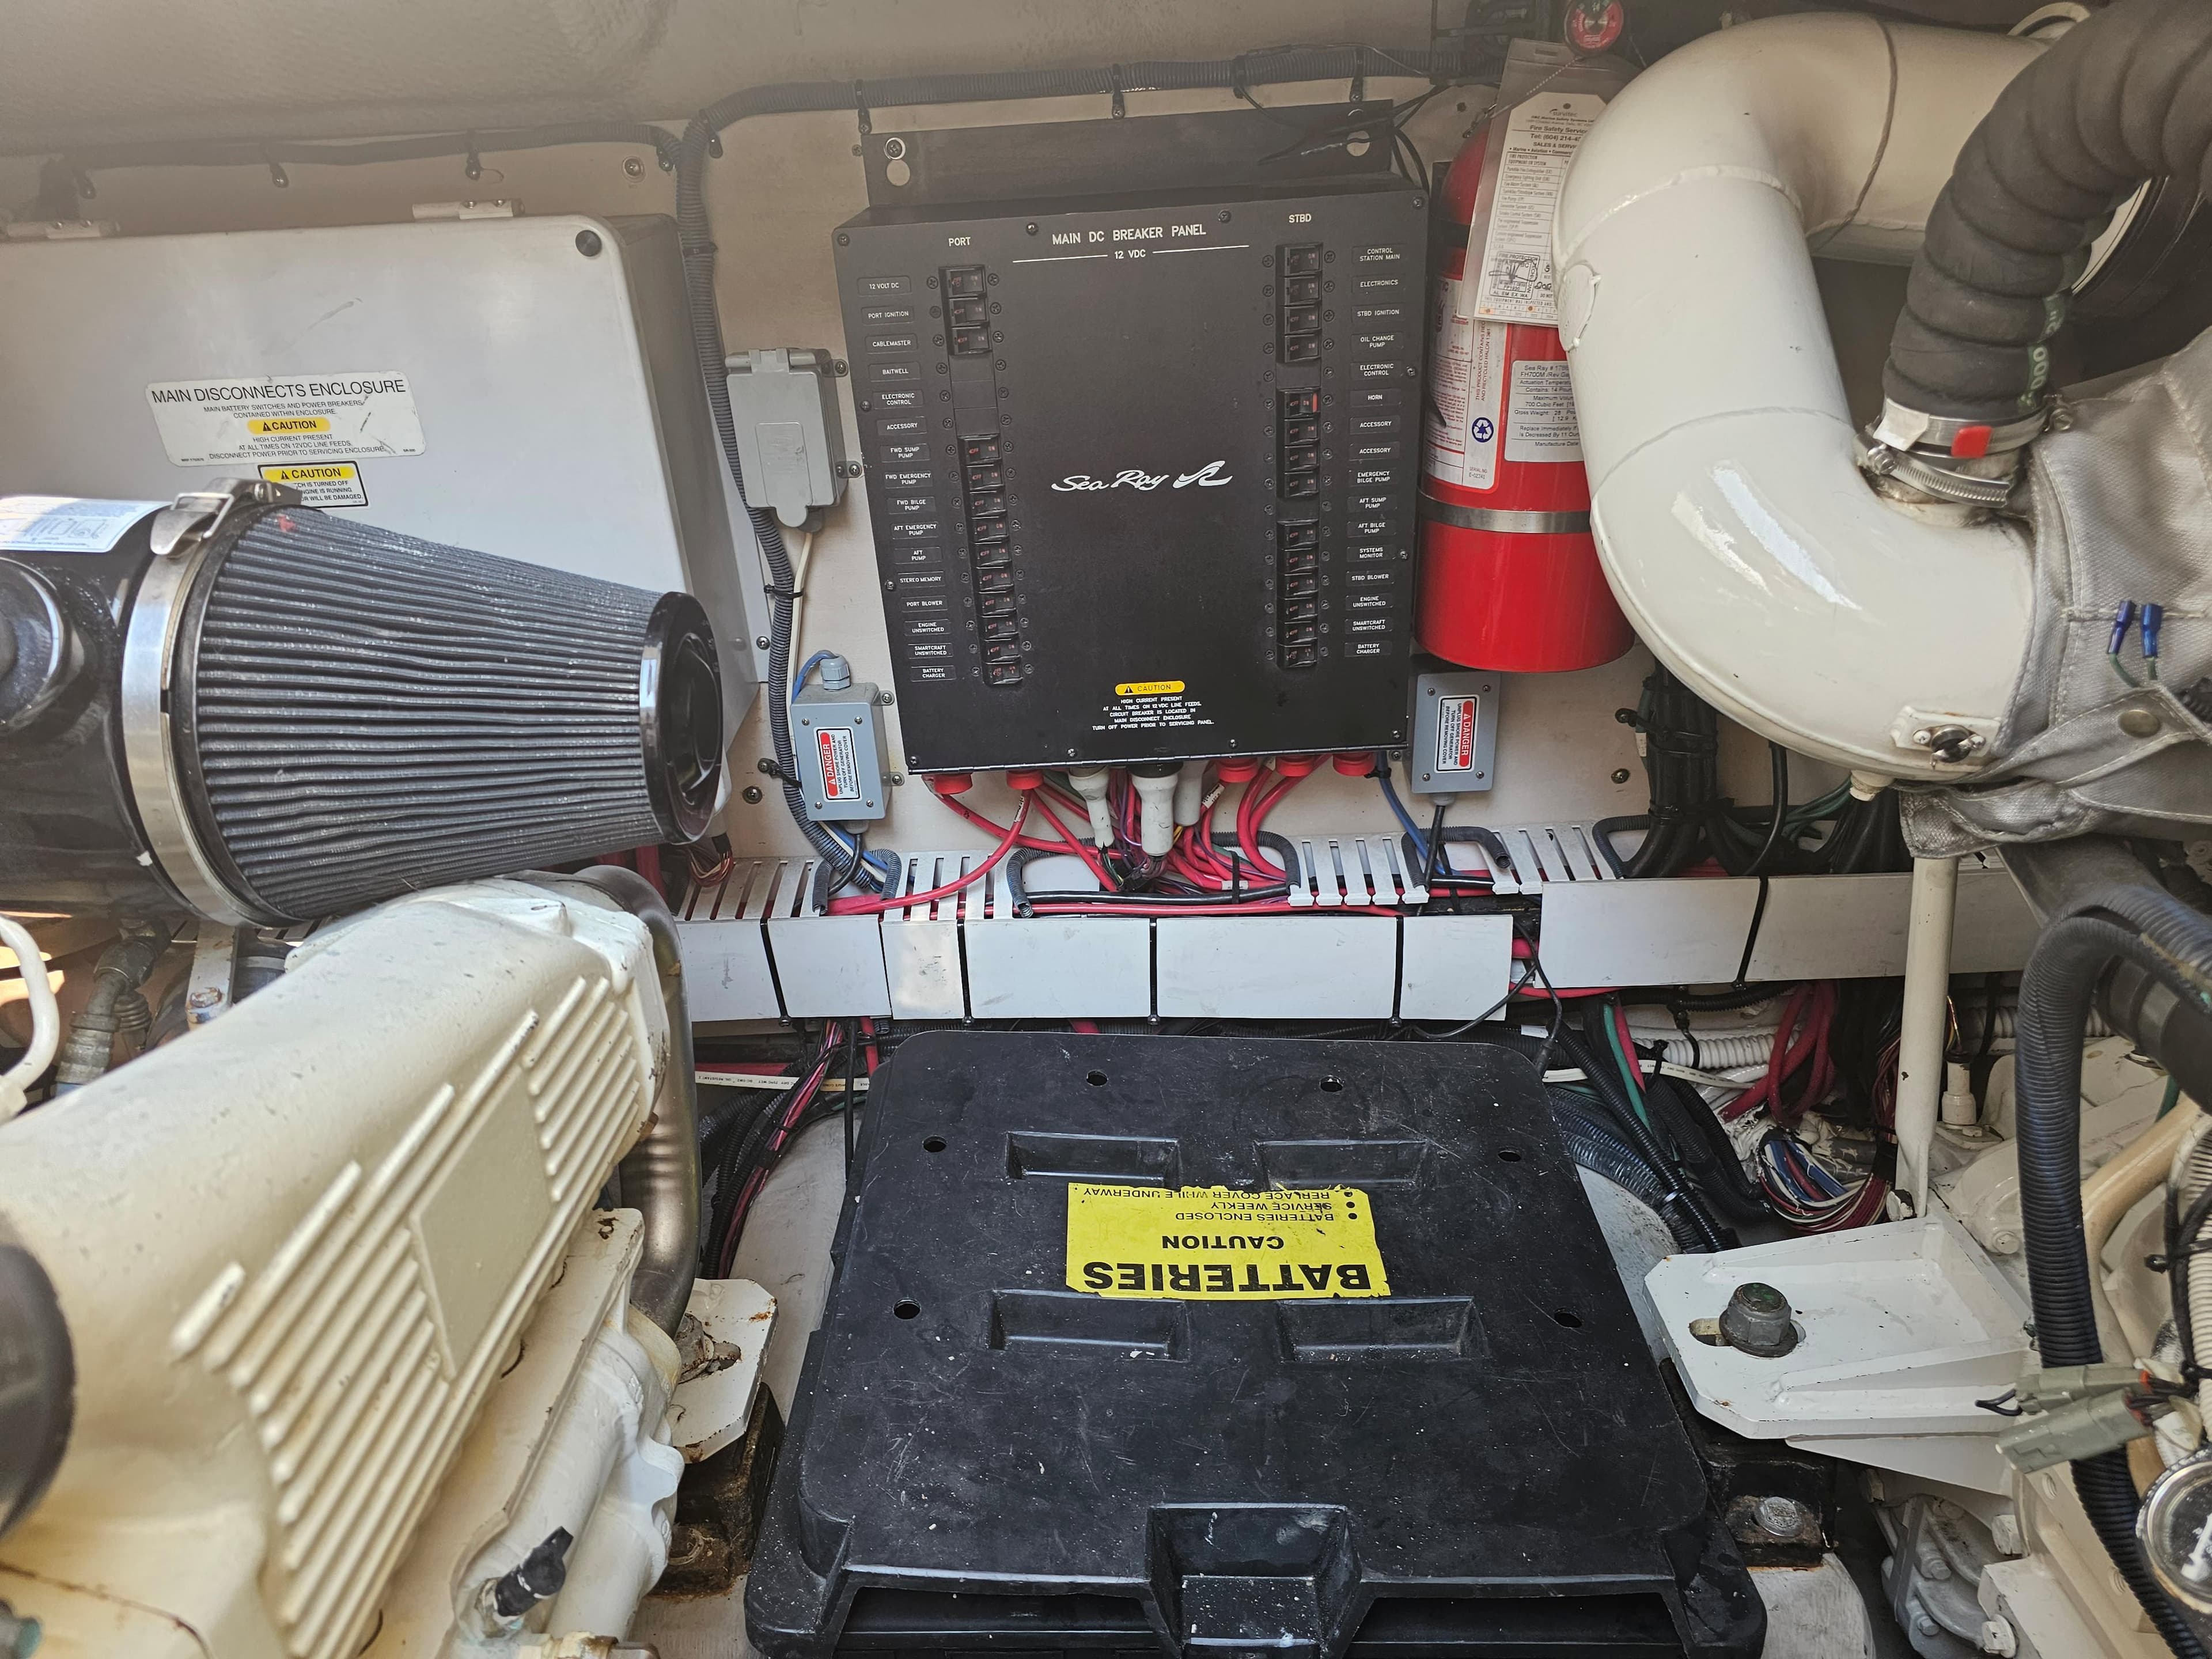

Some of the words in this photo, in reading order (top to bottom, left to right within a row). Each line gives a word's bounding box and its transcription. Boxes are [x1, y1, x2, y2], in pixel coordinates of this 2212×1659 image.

[1289, 214, 1312, 223] STBD
[1052, 233, 1081, 245] MAIN
[1089, 231, 1104, 243] DC
[1113, 227, 1163, 241] BREAKER
[1172, 224, 1206, 237] PANEL
[949, 237, 971, 247] PORT
[1115, 251, 1124, 259] 12
[1128, 249, 1146, 258] VDC
[1360, 279, 1398, 287] ELECTRONICS
[151, 389, 191, 403] MAIN
[194, 384, 306, 401] DISCONNECTS
[309, 380, 406, 396] ENCLOSURE
[272, 421, 317, 430] CAUTION
[291, 468, 341, 479] CAUTION
[1051, 475, 1109, 491] Sea
[1111, 470, 1169, 490] Ray
[1461, 721, 1471, 756] DANGER
[823, 744, 834, 777] DANGER
[1213, 1191, 1260, 1199] COVER
[1211, 1202, 1268, 1210] WEEKLY
[1272, 1202, 1332, 1211] SERVICE
[1176, 1213, 1252, 1221] ENCLOSED
[1257, 1213, 1334, 1222] BATTERIES
[1162, 1236, 1284, 1249] CAUTION
[1083, 1261, 1371, 1292] BATTERIES
